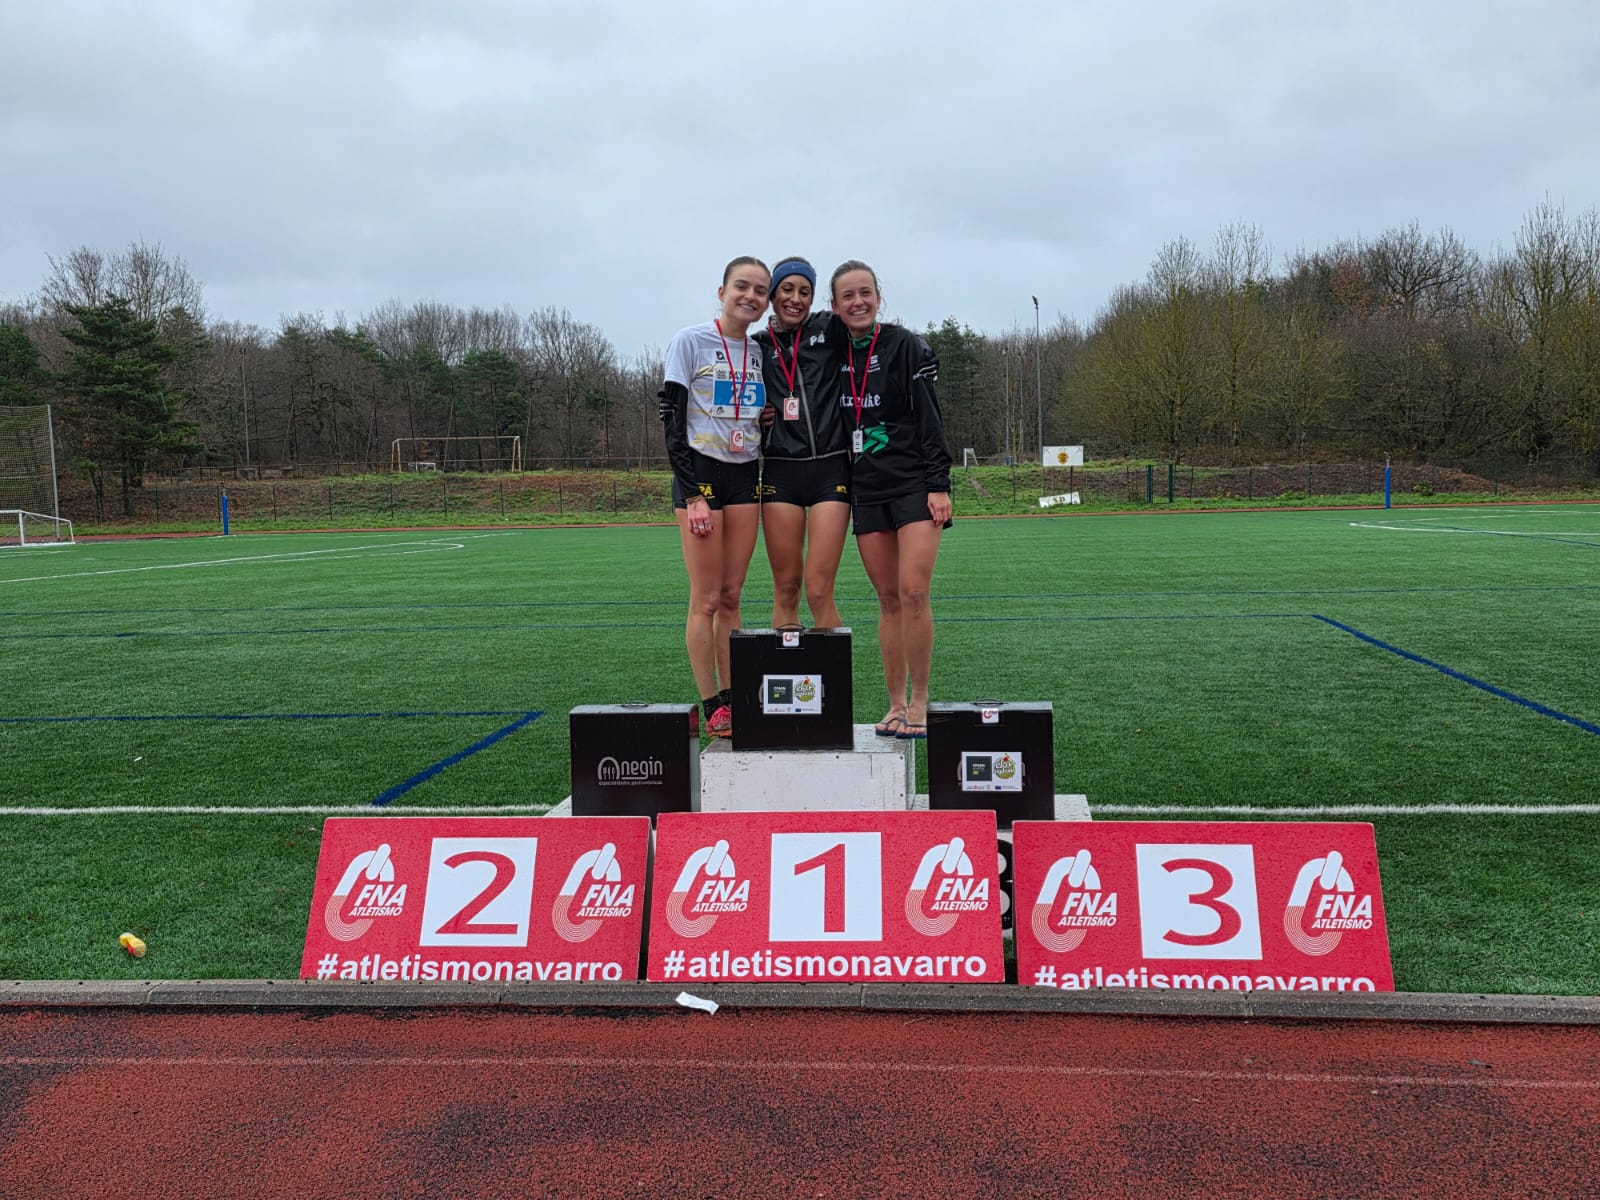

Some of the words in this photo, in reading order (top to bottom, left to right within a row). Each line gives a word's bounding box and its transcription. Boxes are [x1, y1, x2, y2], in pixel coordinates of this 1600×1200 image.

[356, 883, 408, 907] FNA
[435, 851, 523, 935] 2
[583, 884, 636, 907] FNA
[695, 879, 751, 904] FNA
[794, 843, 846, 933] 1
[934, 877, 989, 903] FNA
[348, 906, 404, 918] ATLETISMO
[576, 906, 632, 918] ATLETISMO
[691, 900, 748, 913] ATLETISMO
[930, 900, 989, 911] ATLETISMO
[1062, 892, 1118, 916] FNA
[1161, 858, 1242, 947] 3
[1315, 894, 1373, 919] FNA
[1057, 915, 1117, 927] ATLETISMO
[1311, 916, 1373, 930] ATLETISMO
[316, 953, 623, 981] #atletismonavarro
[664, 949, 987, 978] #atletismonavarro
